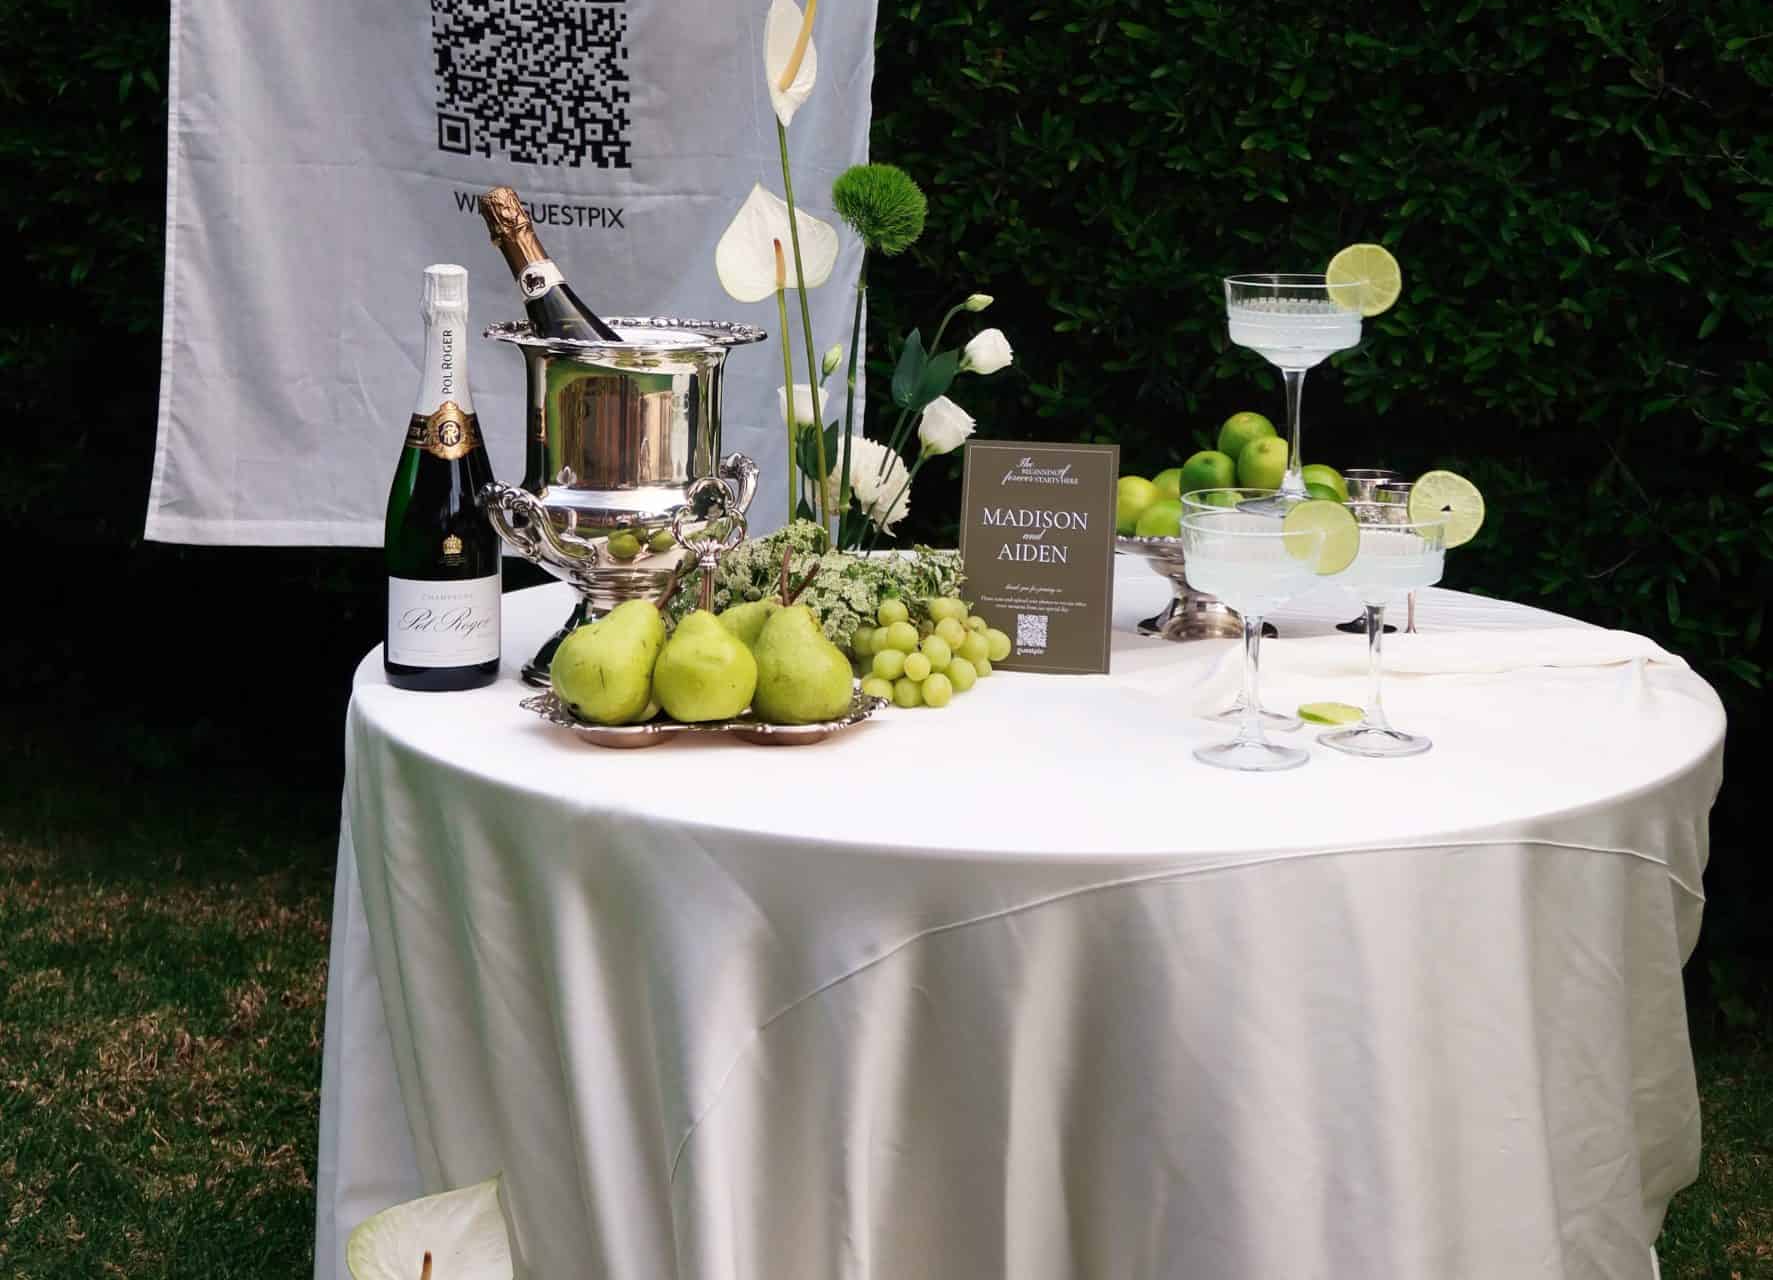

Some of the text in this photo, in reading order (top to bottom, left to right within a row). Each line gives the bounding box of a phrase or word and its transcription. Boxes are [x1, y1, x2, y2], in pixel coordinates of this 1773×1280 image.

[442, 329, 453, 395] POL ROGER
[983, 507, 1088, 530] MADISON
[1022, 528, 1047, 540] and
[997, 543, 1068, 564] AIDEN
[401, 607, 434, 632] Pol
